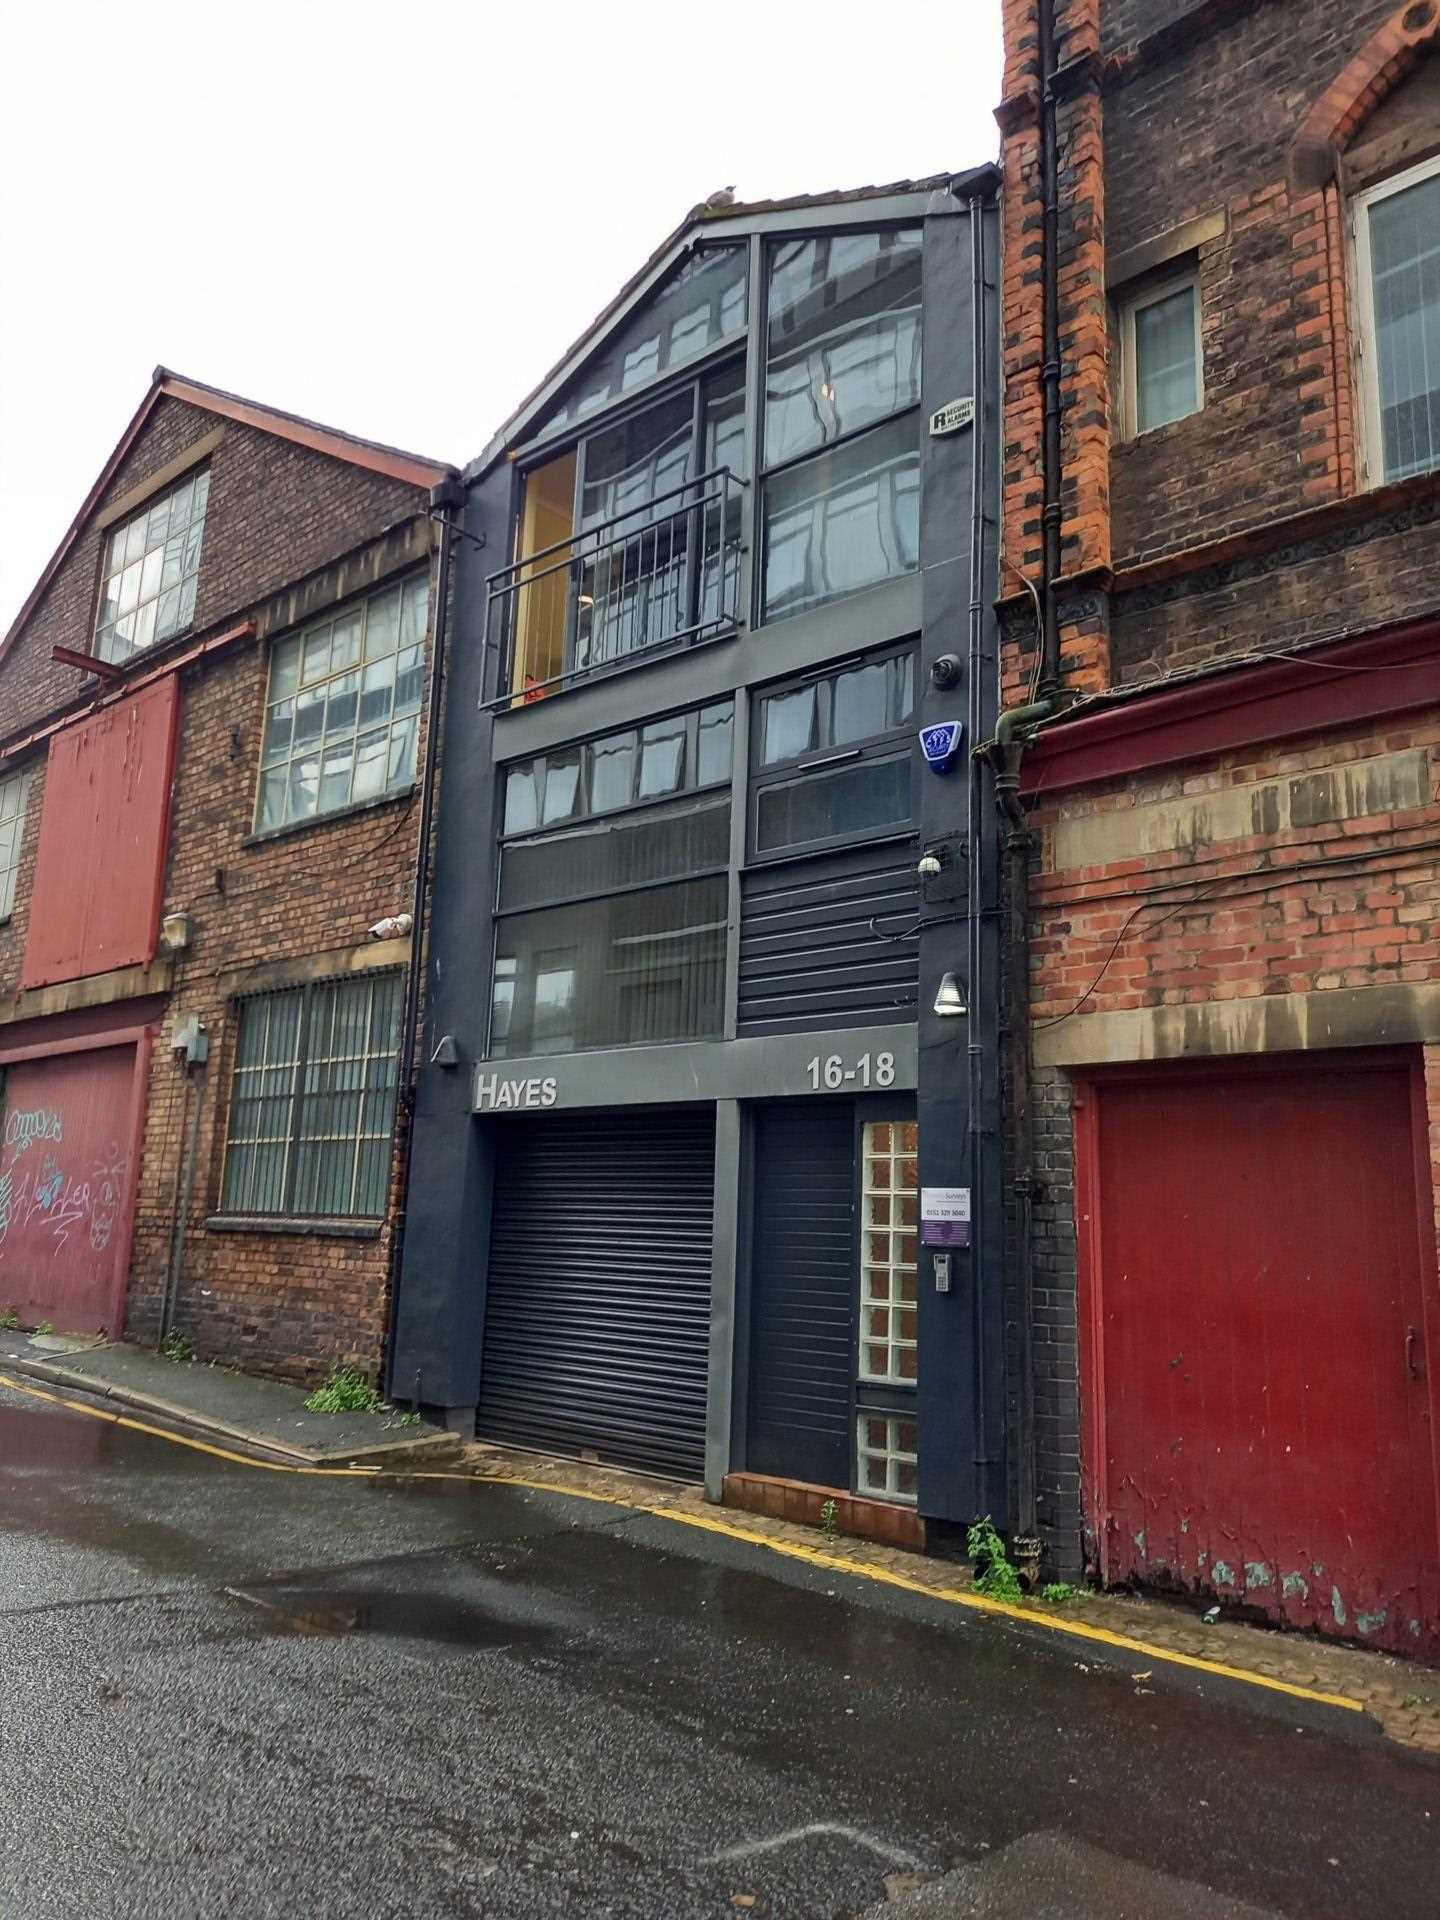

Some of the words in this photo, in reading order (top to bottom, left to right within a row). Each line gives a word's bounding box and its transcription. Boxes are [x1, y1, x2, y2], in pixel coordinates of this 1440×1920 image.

[934, 412, 946, 430] R
[807, 1051, 895, 1089] 16-18
[476, 1073, 557, 1110] HAYES
